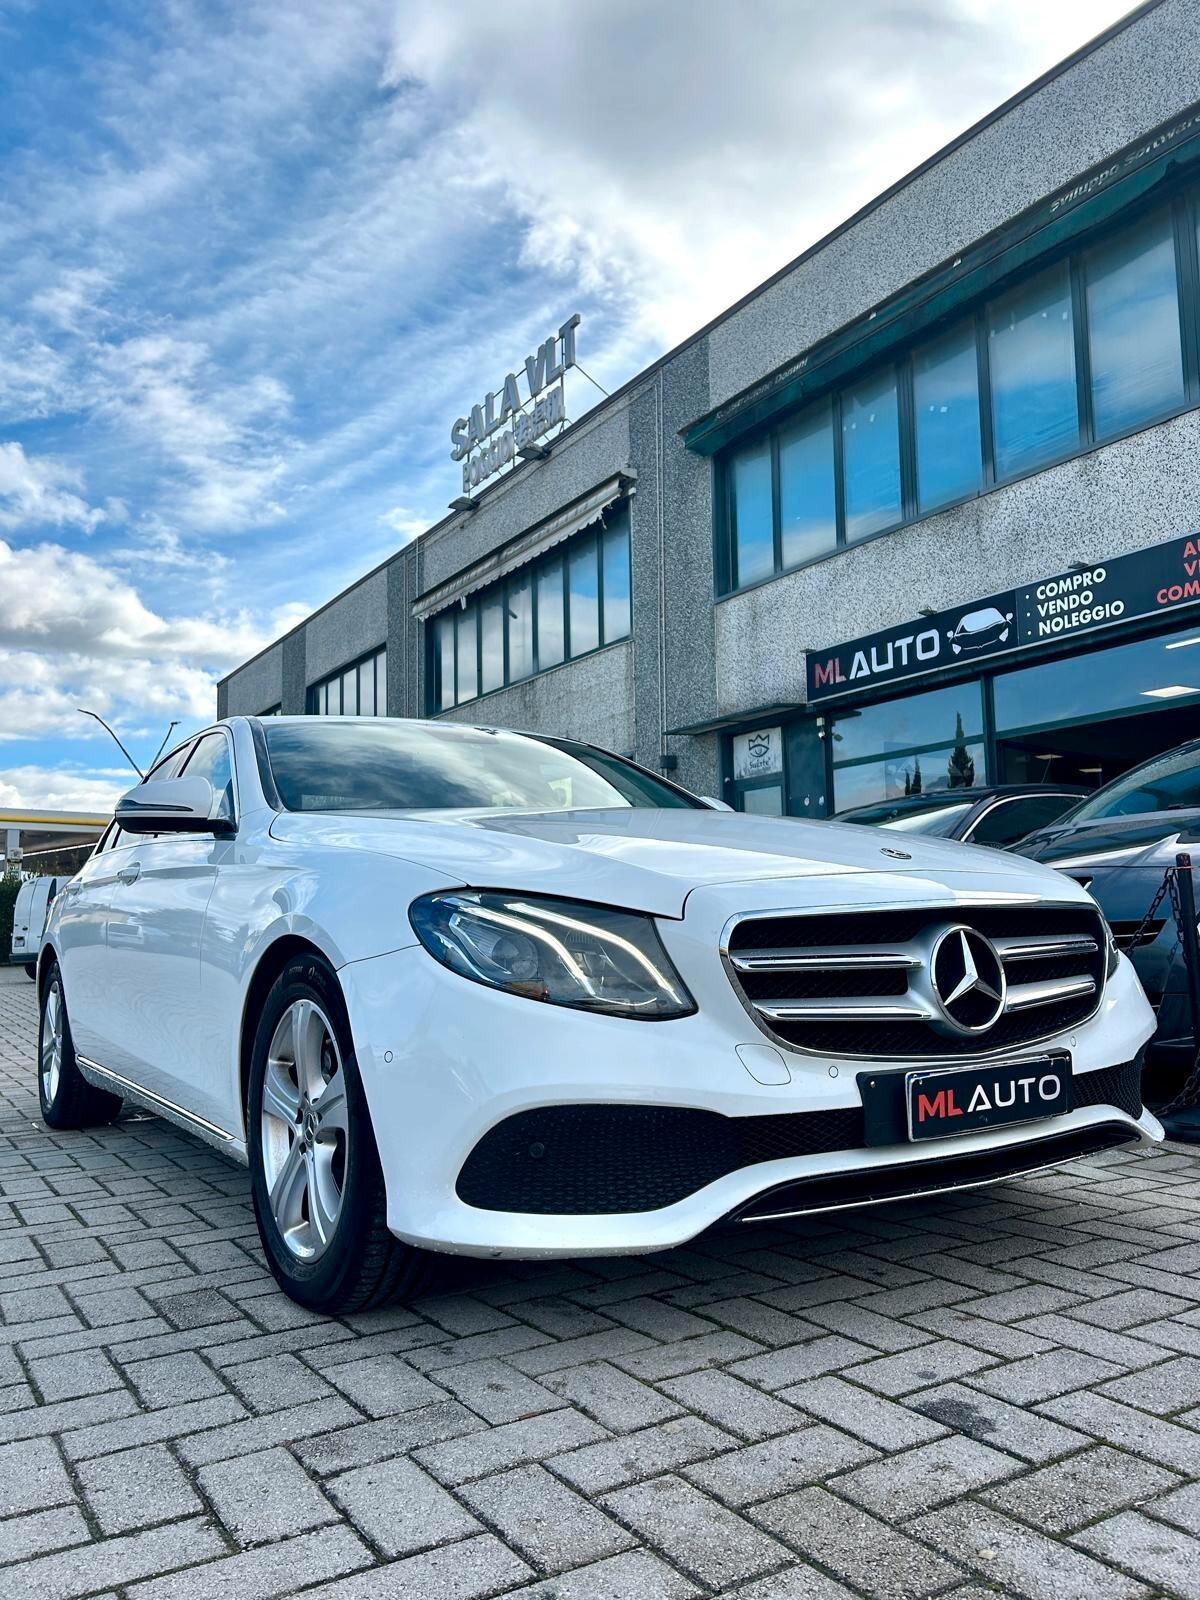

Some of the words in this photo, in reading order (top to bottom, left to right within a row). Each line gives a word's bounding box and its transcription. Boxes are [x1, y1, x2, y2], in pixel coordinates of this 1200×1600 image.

[451, 373, 521, 461] SALA
[525, 313, 581, 398] VLT
[1184, 539, 1200, 558] A
[1036, 568, 1107, 600] COMPRO
[1184, 559, 1200, 577] V
[1037, 590, 1093, 617] VENDO
[1038, 600, 1125, 637] NOLEGGIO
[814, 657, 847, 689] ML
[849, 628, 940, 680] AUTO
[918, 1089, 964, 1122] ML
[967, 1074, 1061, 1113] AUTO
